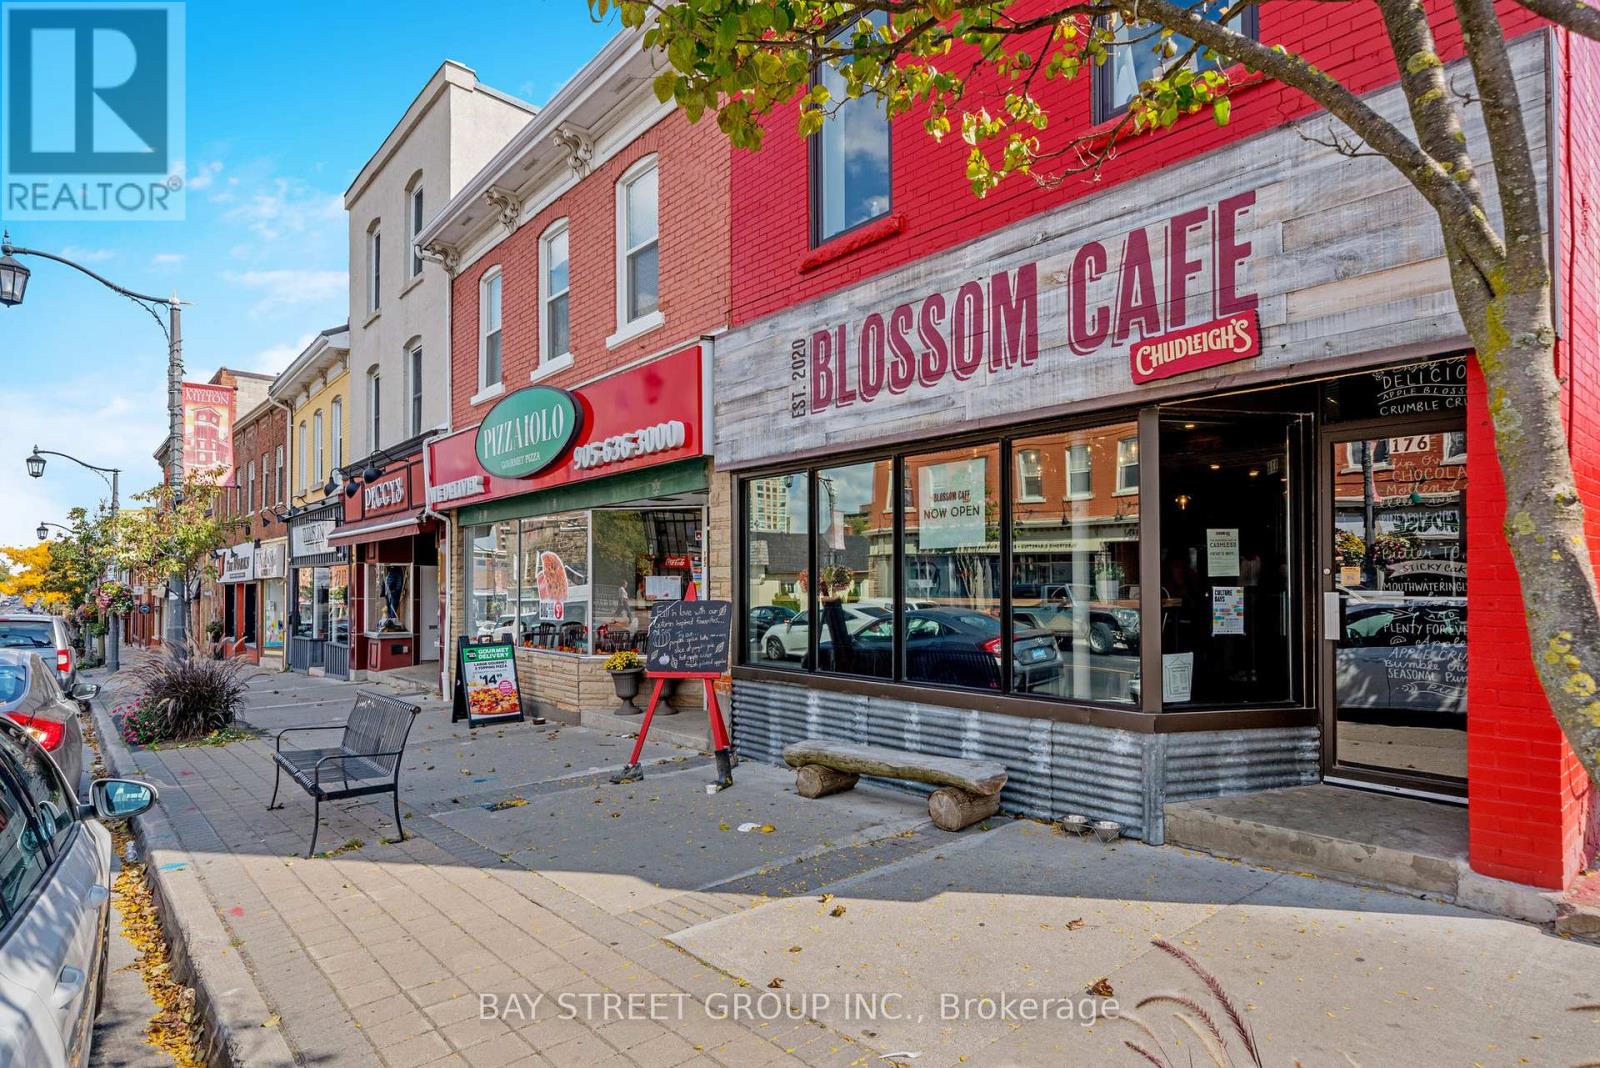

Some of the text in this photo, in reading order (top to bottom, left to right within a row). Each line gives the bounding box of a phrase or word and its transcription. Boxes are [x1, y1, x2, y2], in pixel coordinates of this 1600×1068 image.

[810, 191, 1258, 415] BLOSSOM CAFE
[1135, 317, 1254, 377] CHUDLEIGH'S
[791, 339, 806, 418] EST. 2020
[1383, 386, 1467, 400] APPLE BLOSS
[1380, 400, 1439, 416] CRUMBLE
[483, 403, 564, 459] PIZZAIOLO
[1392, 436, 1428, 452] 176
[525, 452, 540, 464] PIZZA
[933, 491, 956, 502] BLOSSOM
[924, 505, 980, 519] NOW OPEN
[1402, 563, 1442, 573] STICKY
[680, 606, 692, 616] love
[1384, 622, 1423, 634] PLENTY
[1388, 647, 1431, 660] APPLE
[1388, 668, 1436, 681] SEASONAL
